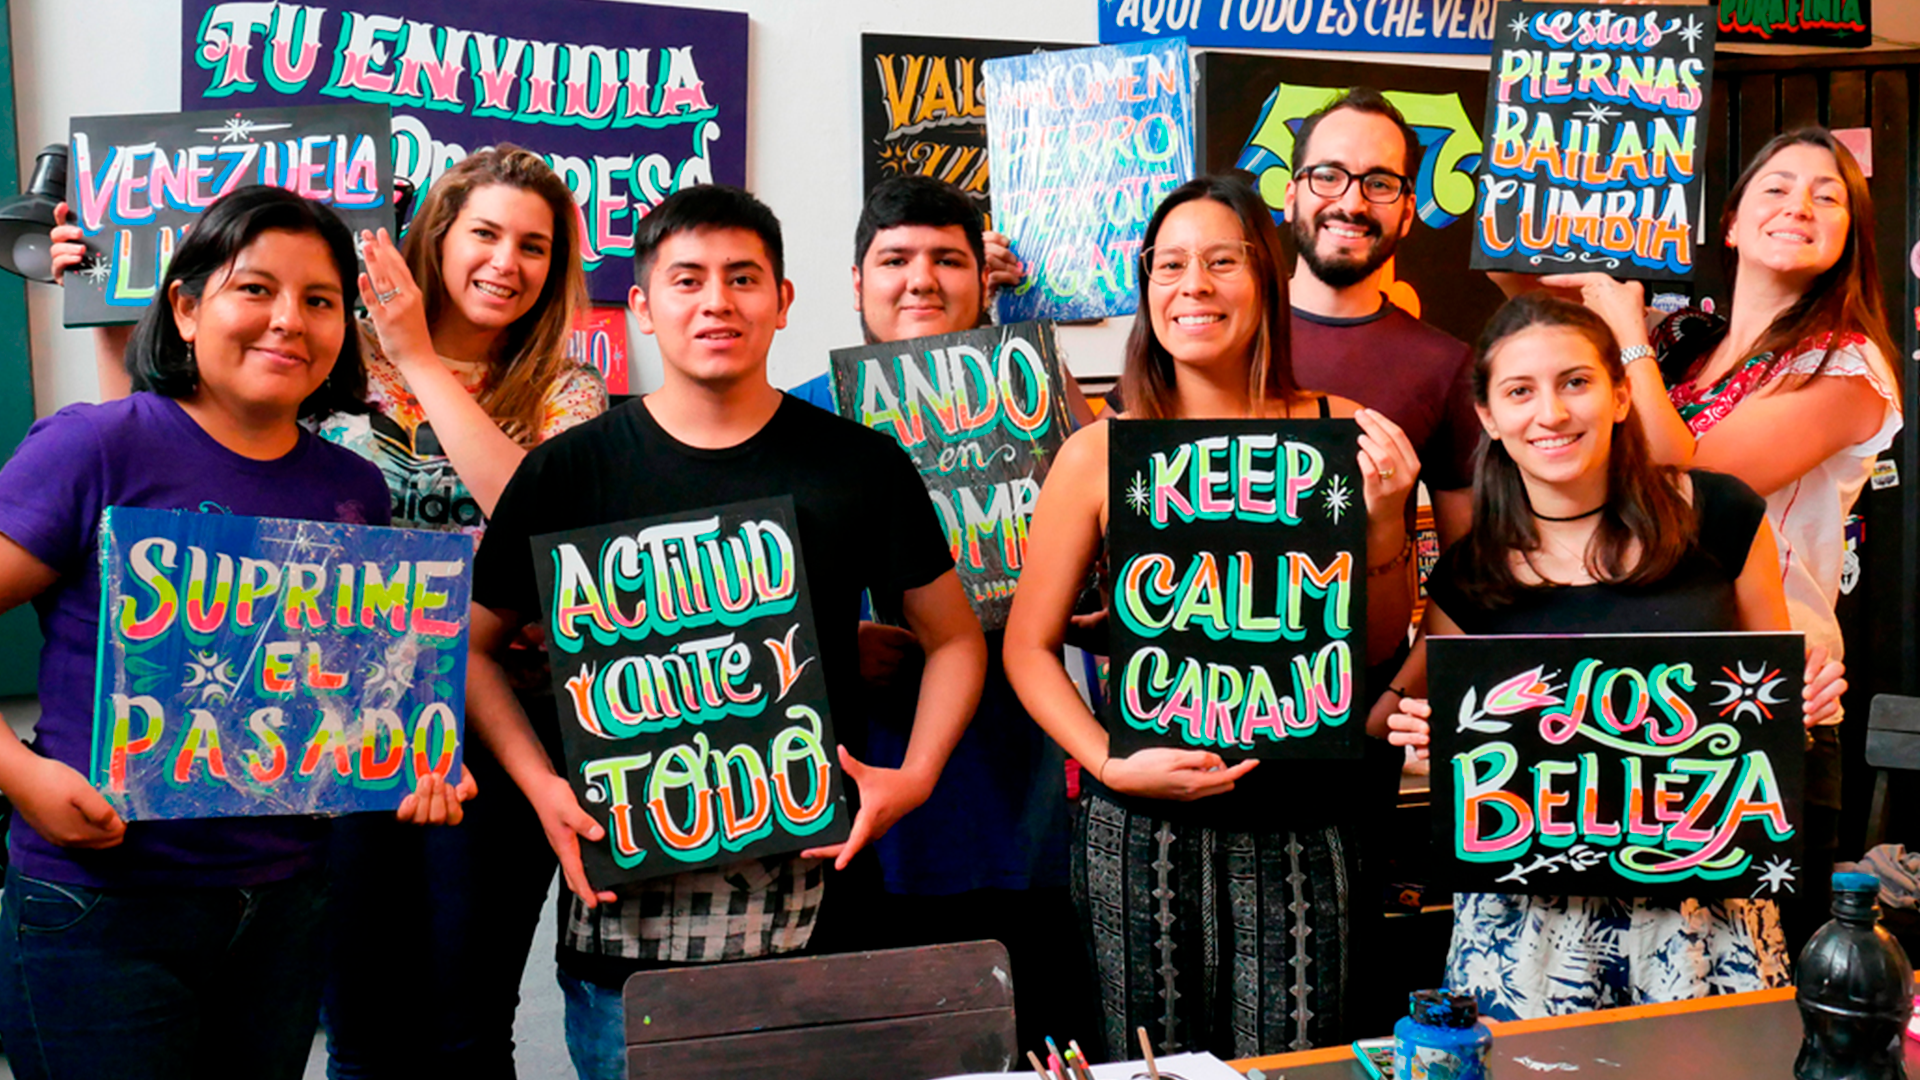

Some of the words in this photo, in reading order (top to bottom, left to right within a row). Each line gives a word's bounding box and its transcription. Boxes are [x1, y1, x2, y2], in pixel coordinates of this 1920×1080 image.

[194, 0, 328, 98] TU
[319, 10, 718, 130] ENVIDIA
[1218, 0, 1311, 34] TODO
[1316, 0, 1358, 36] ES
[1529, 8, 1682, 52] estas
[1498, 49, 1705, 115] PIERNAS
[72, 132, 386, 237] VENEZUELA
[1490, 103, 1697, 190] BAILAN
[1044, 238, 1144, 306] GAT
[1478, 174, 1693, 274] CUMBIA
[854, 336, 1051, 452] ANDO
[1151, 434, 1324, 528] KEEP
[120, 536, 465, 655] SUPRIME
[1115, 552, 1354, 641] CALM
[256, 641, 350, 697] EL
[597, 631, 764, 738] ante
[1122, 640, 1352, 748] CARAJO
[1538, 658, 1741, 757] LOS
[108, 693, 462, 796] PASADO
[584, 704, 838, 869] TODO
[1453, 741, 1795, 884] BELLEZA
